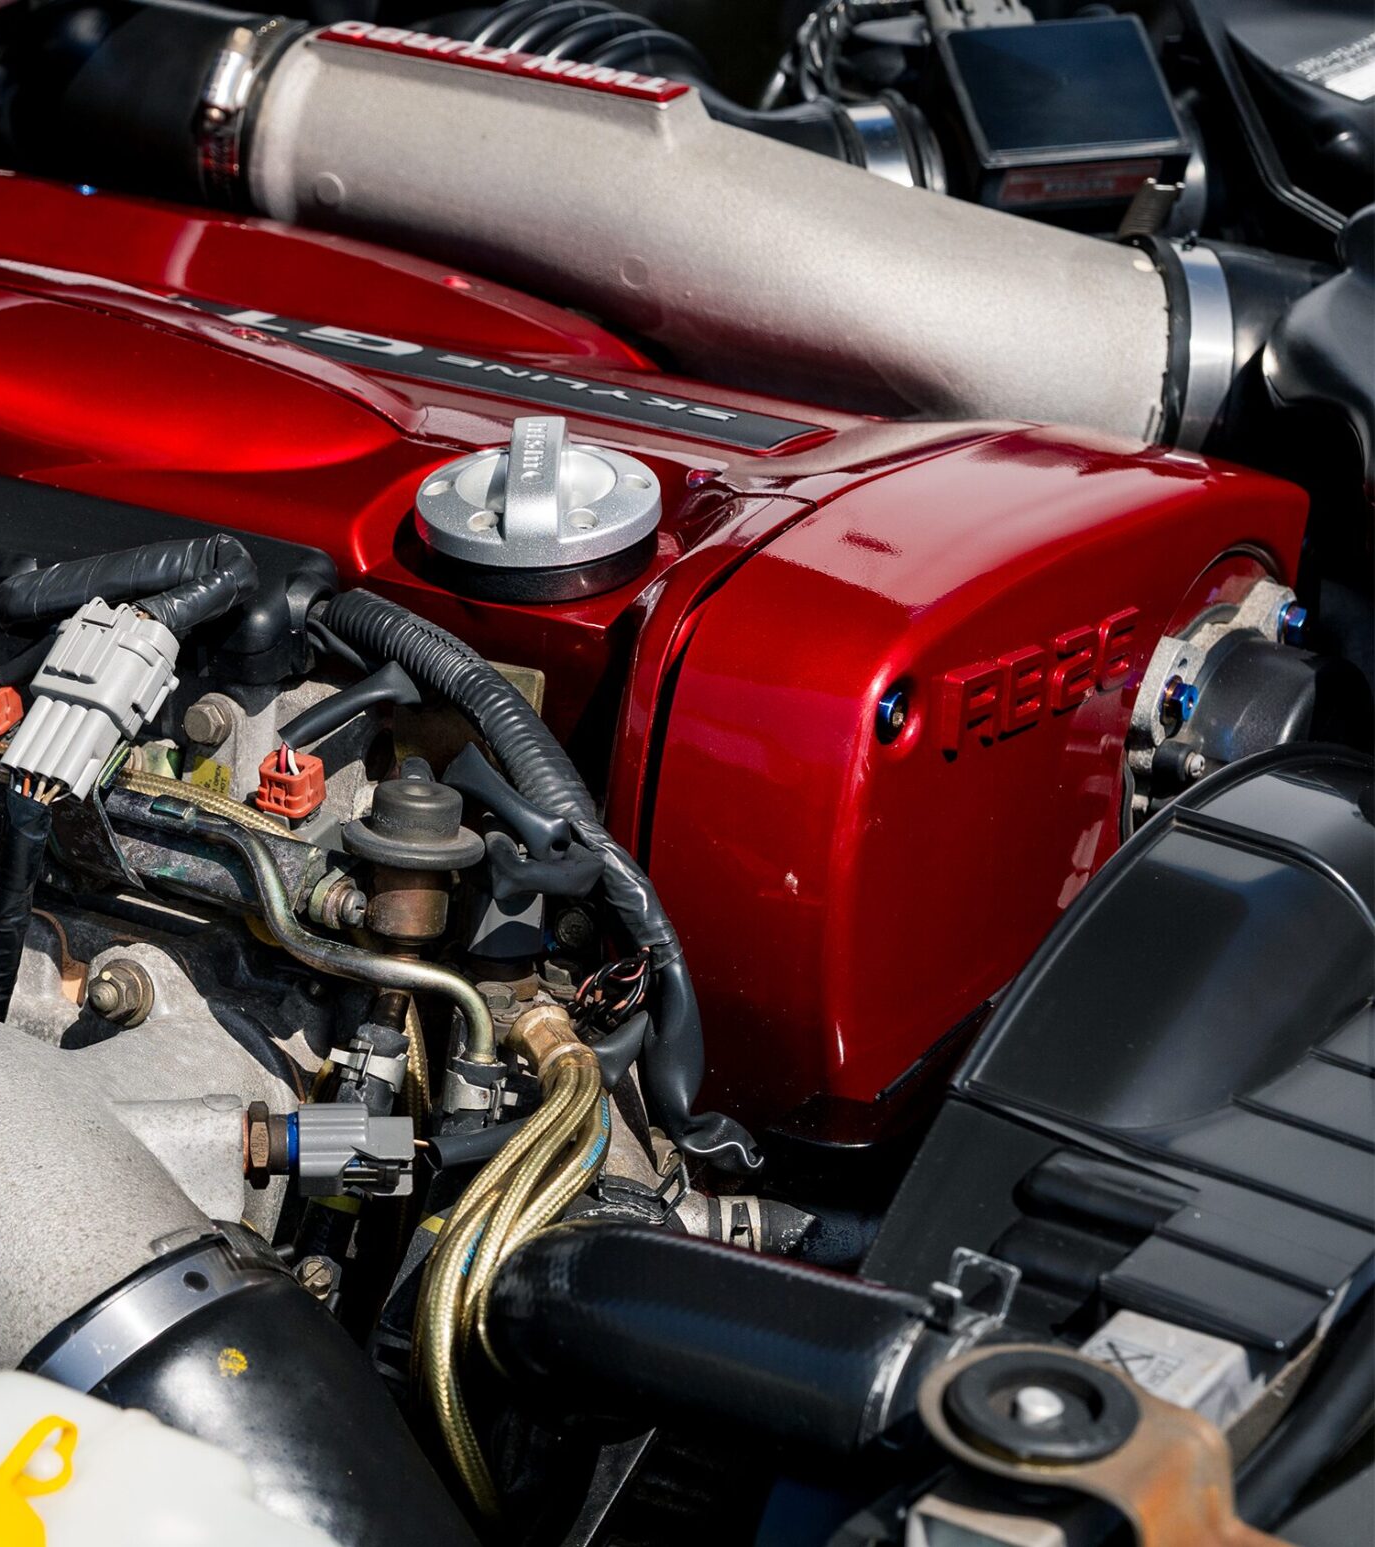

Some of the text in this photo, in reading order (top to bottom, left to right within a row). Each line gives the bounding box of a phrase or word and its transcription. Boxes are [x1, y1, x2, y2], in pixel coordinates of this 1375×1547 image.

[329, 20, 668, 94] TWIN TURBO
[435, 354, 738, 423] SKYLINE
[941, 606, 1139, 757] RB26
